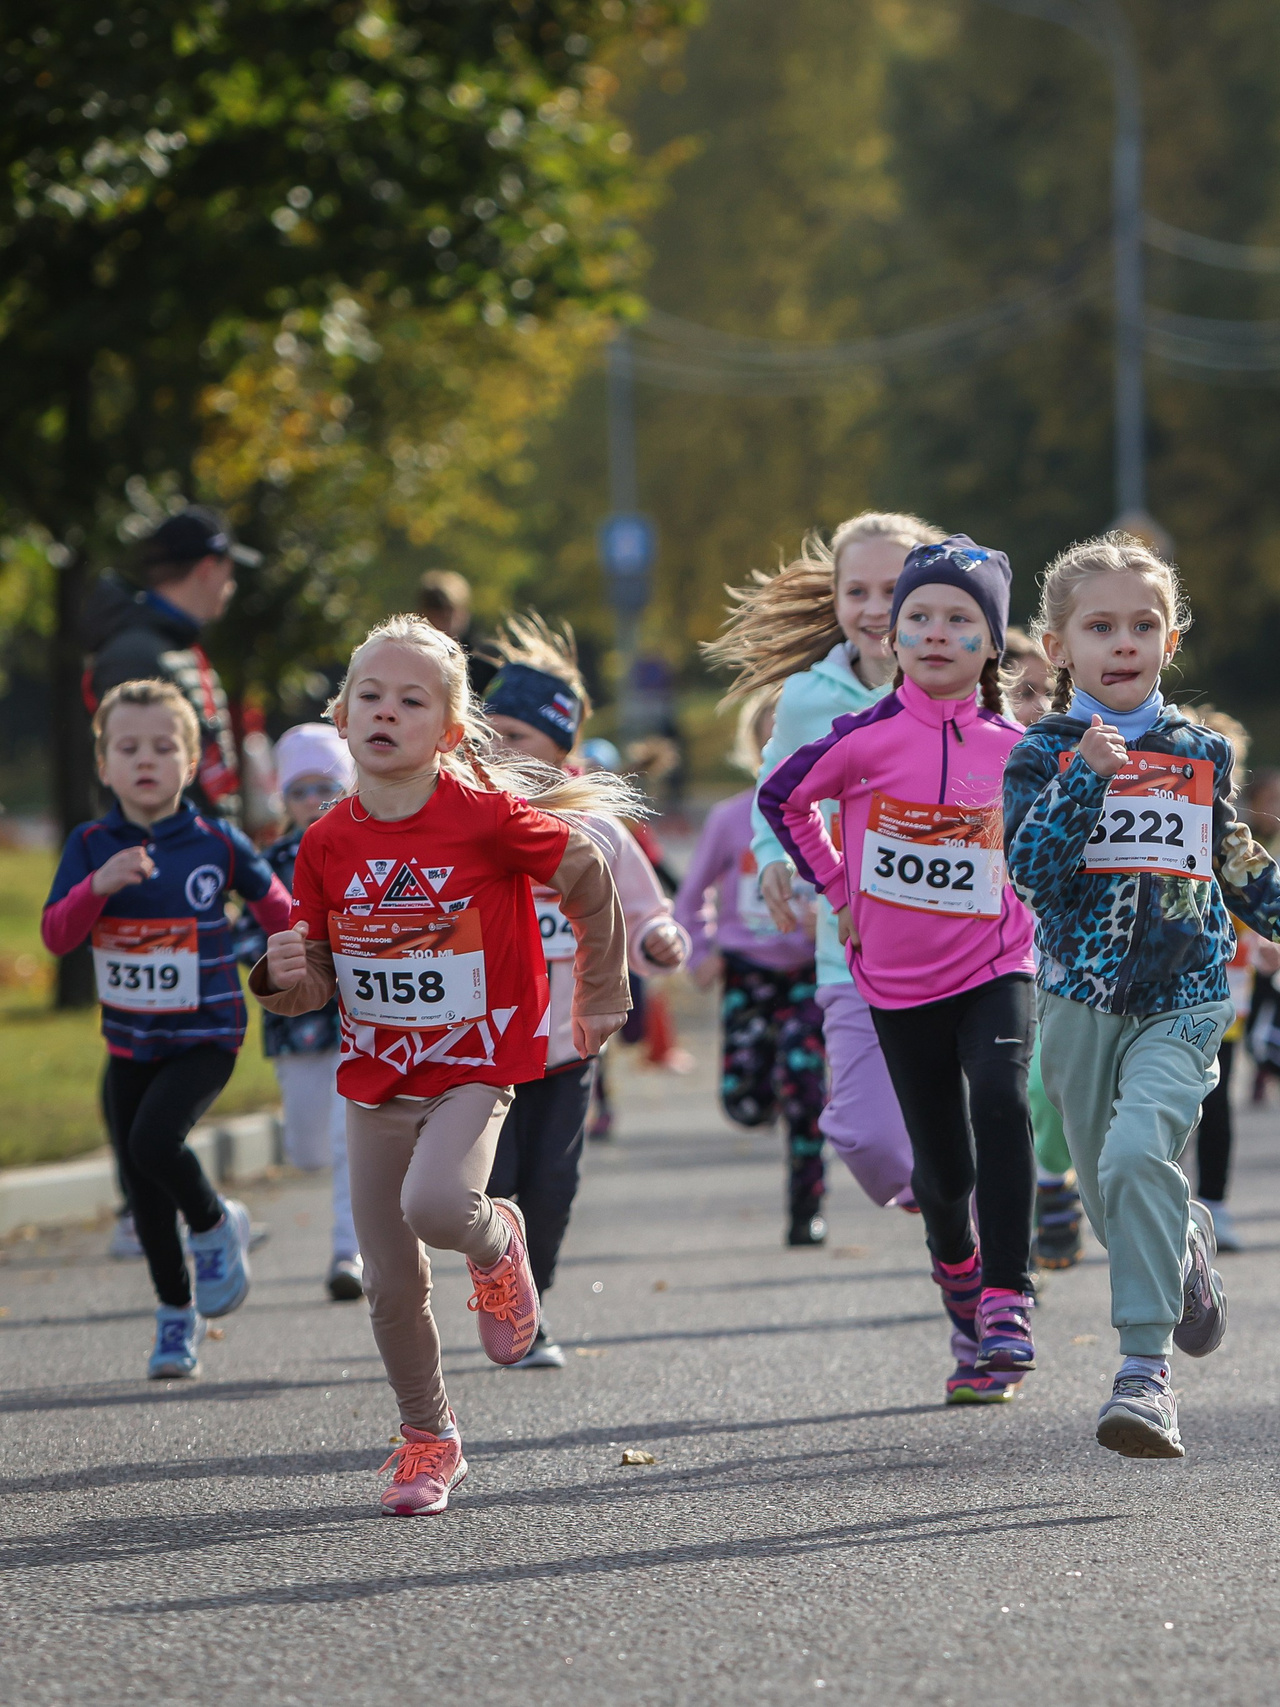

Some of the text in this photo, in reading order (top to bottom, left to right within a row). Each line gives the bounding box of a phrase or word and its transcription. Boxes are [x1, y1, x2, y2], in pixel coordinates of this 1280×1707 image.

[874, 846, 975, 891] 3082
[106, 960, 179, 989] 3319
[352, 968, 445, 1004] 3158
